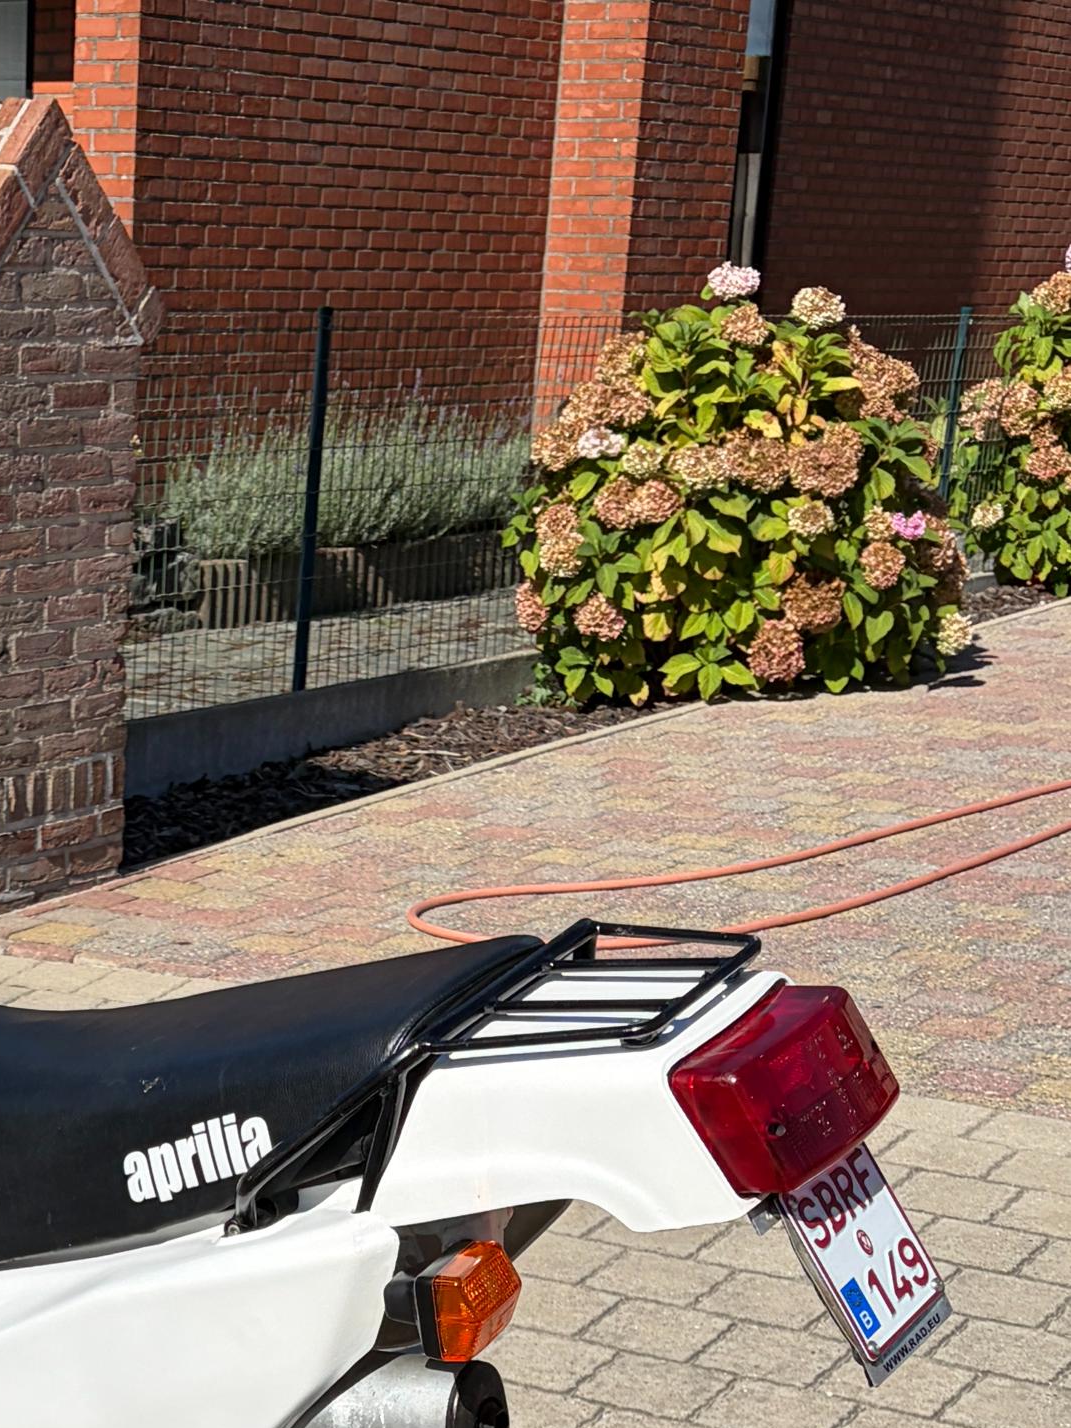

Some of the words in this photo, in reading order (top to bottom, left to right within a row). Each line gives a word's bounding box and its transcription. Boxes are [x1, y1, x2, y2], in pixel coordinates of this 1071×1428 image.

[123, 1112, 273, 1204] aprilia
[797, 1148, 872, 1250] SBRF
[867, 1237, 930, 1317] 149
[859, 1309, 874, 1330] B
[882, 1312, 942, 1374] WWW.RAD.EU
